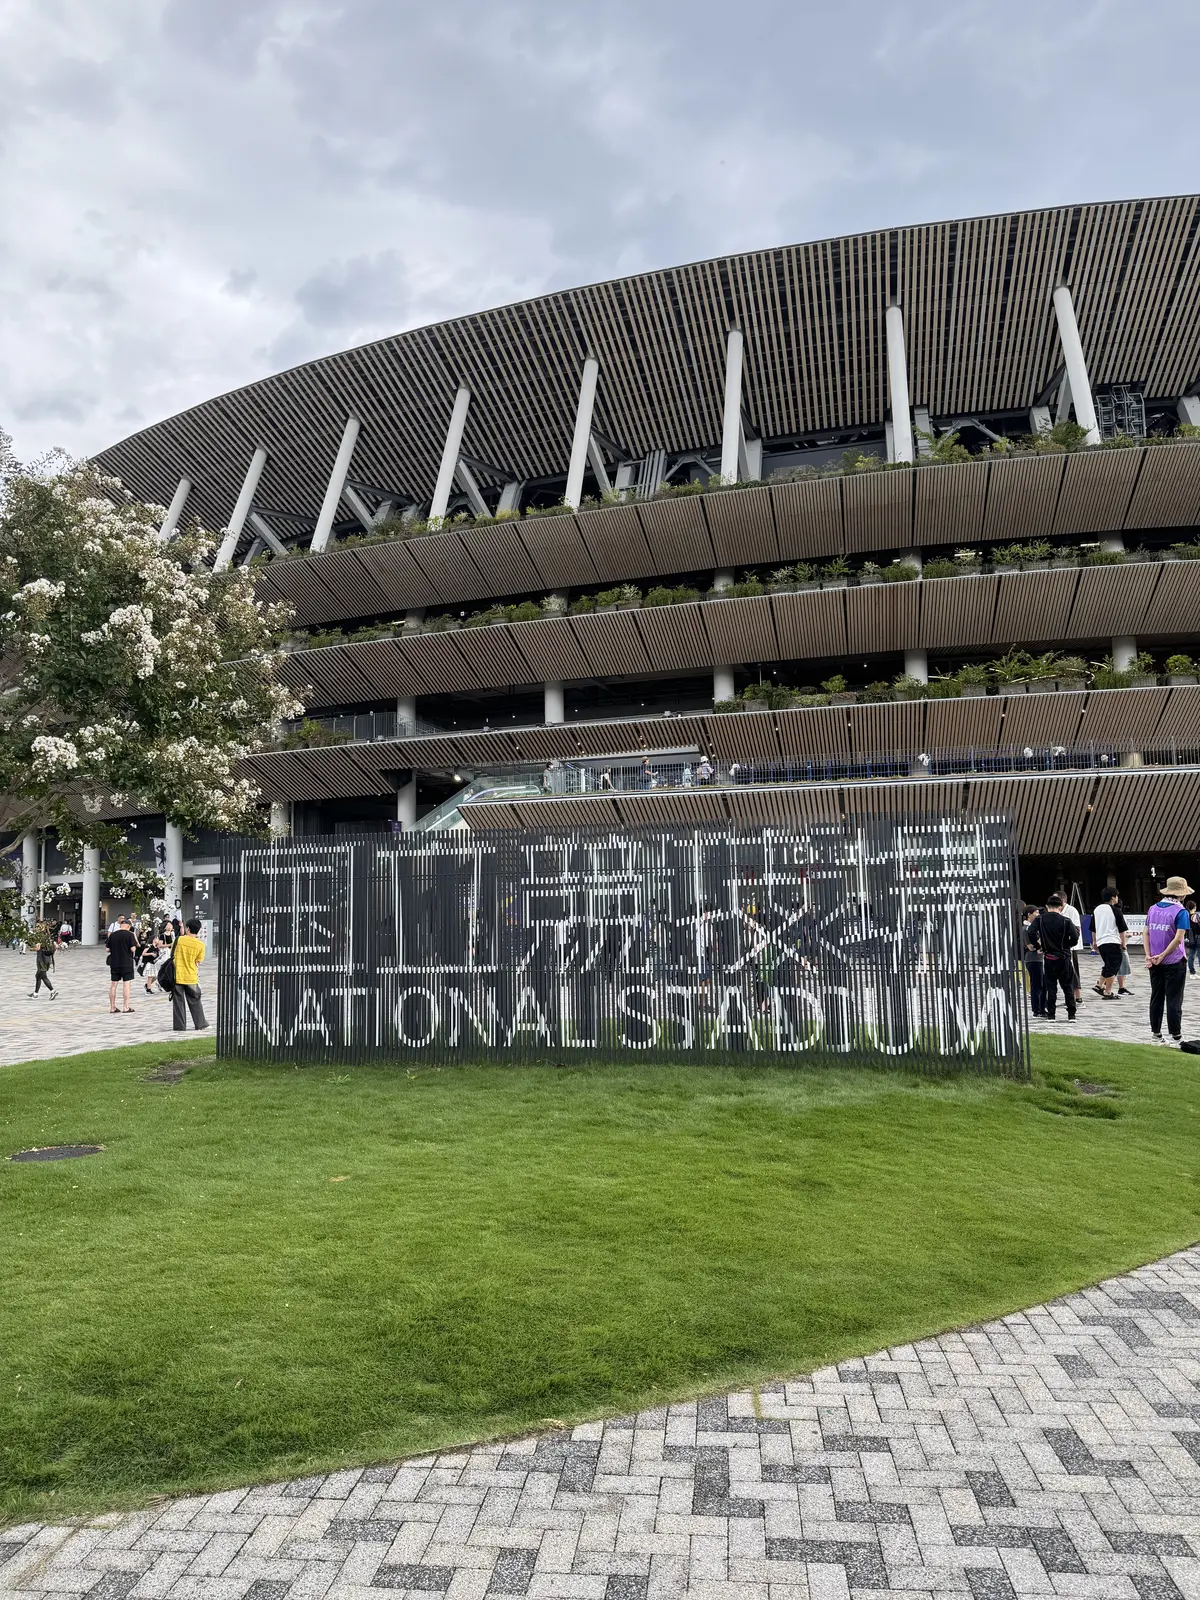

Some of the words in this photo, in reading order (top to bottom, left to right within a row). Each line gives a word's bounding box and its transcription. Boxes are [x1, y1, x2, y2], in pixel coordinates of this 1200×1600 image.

[195, 879, 209, 891] E1
[238, 815, 1009, 976] 国立競技場
[28, 905, 36, 914] D
[1149, 923, 1170, 931] STAFF
[237, 985, 598, 1048] NATIONAL
[617, 984, 1010, 1057] STADIUM
